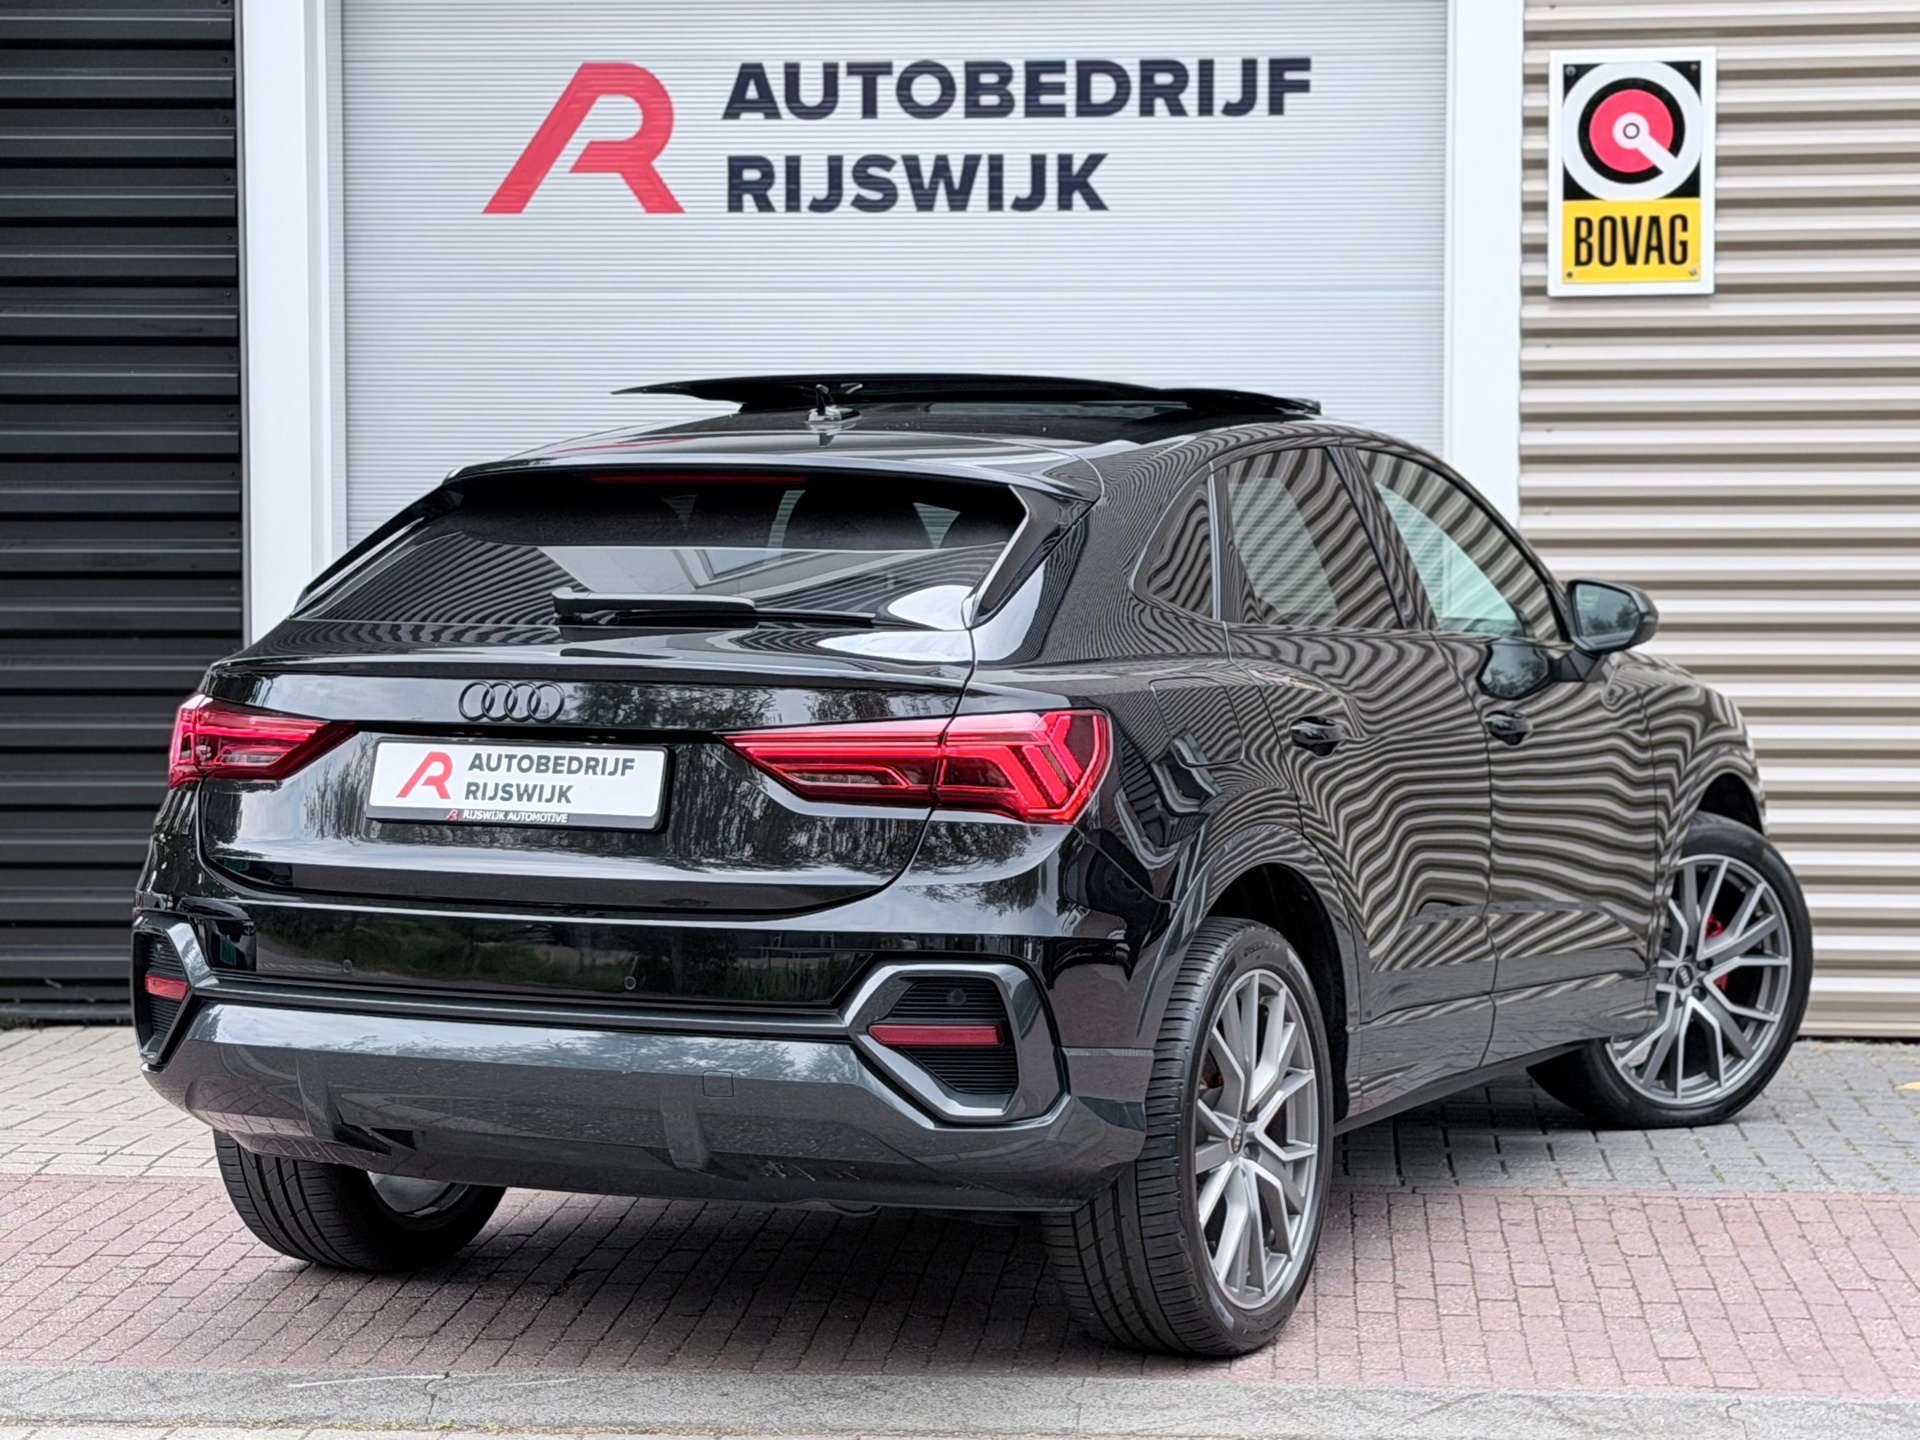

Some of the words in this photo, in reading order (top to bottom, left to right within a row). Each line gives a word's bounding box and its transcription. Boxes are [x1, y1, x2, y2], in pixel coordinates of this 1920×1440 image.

[722, 58, 1311, 120] AUTOBEDRIJF
[727, 153, 1108, 213] RIJSWIJK
[1574, 214, 1689, 267] BOVAG
[468, 752, 636, 777] AUTOBEDRIJF
[464, 781, 574, 805] RIJSWIJK
[462, 809, 506, 821] RIJSWIJK
[507, 811, 569, 823] AUTOMOTIVE
